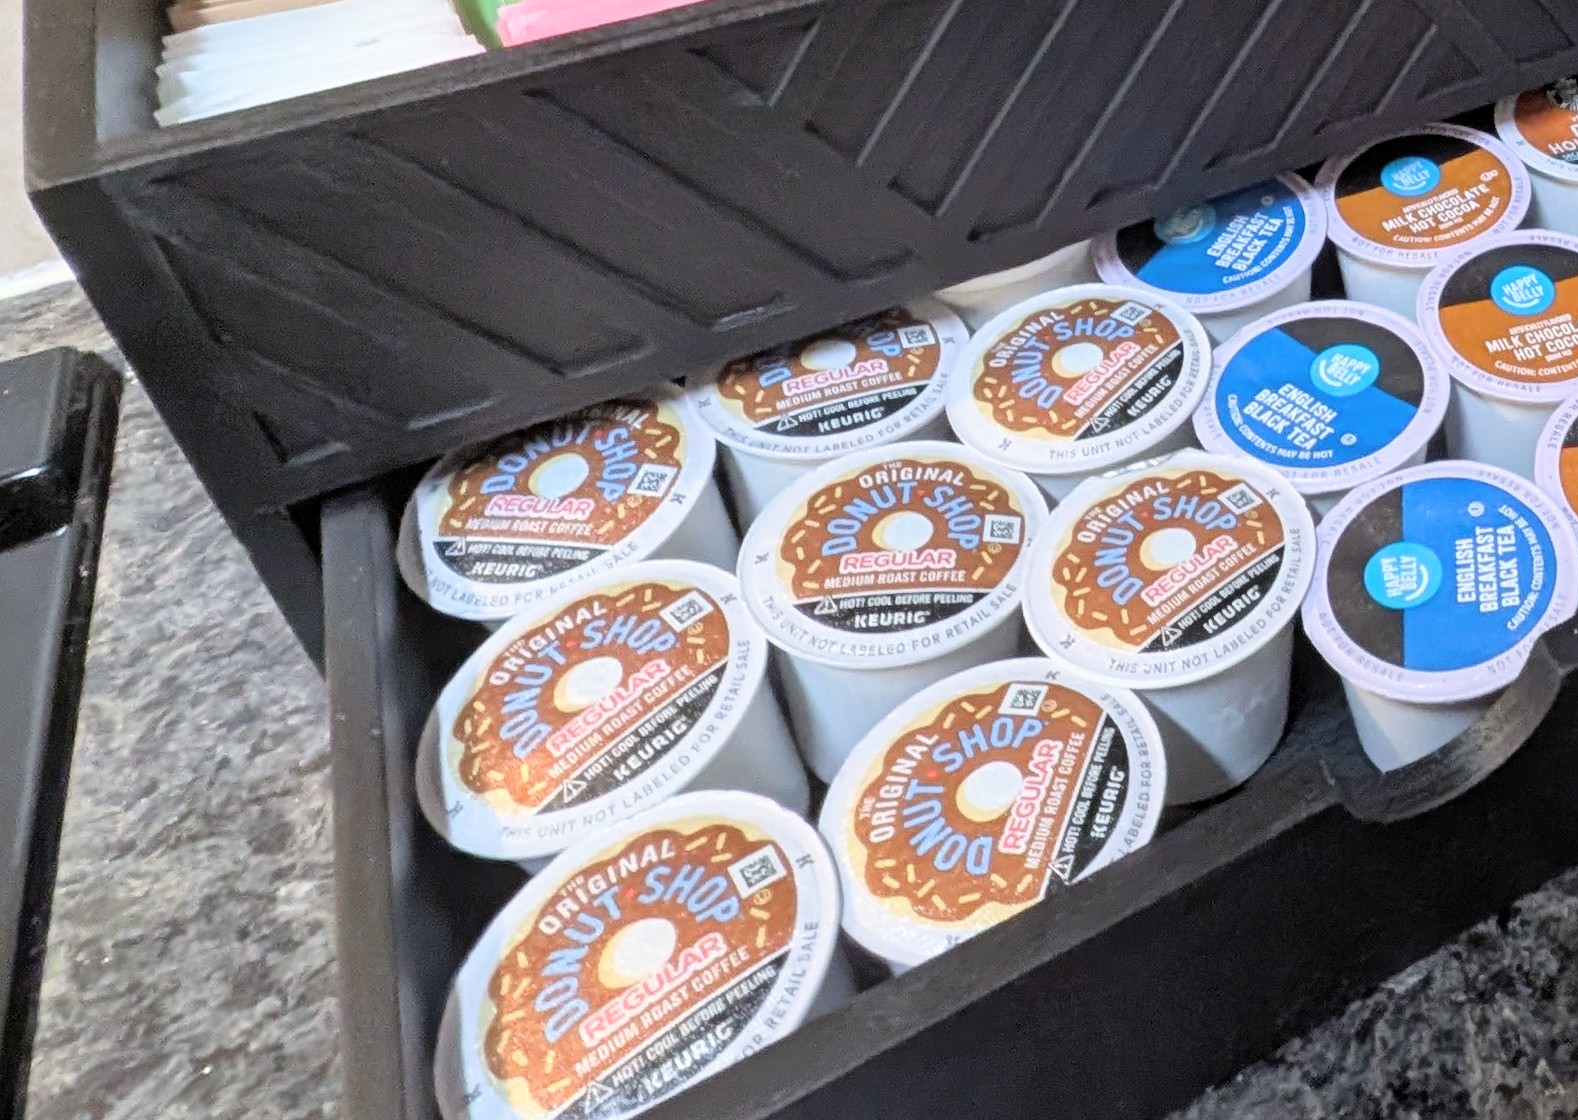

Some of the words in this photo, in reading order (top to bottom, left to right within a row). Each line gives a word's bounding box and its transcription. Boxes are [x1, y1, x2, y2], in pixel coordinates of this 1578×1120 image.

[1392, 162, 1423, 180] HAPPY
[1400, 170, 1430, 187] BELLY
[1382, 215, 1419, 232] MILK
[1418, 184, 1490, 218] CHOCOLATE
[1409, 217, 1435, 234] HOT
[1438, 201, 1480, 223] COCOA
[1207, 215, 1249, 257] ENGLISH
[1216, 212, 1269, 268] BREAKFAST
[1232, 237, 1268, 271] BLACK
[1259, 218, 1284, 237] TEA
[1502, 274, 1538, 295] HAPPY
[1511, 285, 1544, 303] BELLY
[989, 312, 1065, 368] ORIGINAL
[1012, 335, 1063, 408] DONUT
[1052, 318, 1134, 341] SHOP
[1331, 352, 1373, 373] HAPPY
[1485, 337, 1523, 353] MILK
[1514, 343, 1542, 362] HOT
[776, 390, 822, 411] MEDIUM
[825, 383, 858, 398] ROAST
[862, 372, 902, 387] COFFEE
[783, 359, 888, 395] REGULAR
[1064, 341, 1141, 405] REGULAR
[1075, 391, 1106, 419] MEDIUM
[1105, 369, 1129, 394] ROAST
[1129, 346, 1158, 369] COFFEE
[1326, 363, 1362, 385] BELLY
[1494, 361, 1536, 377] CAUTION:
[818, 408, 884, 432] KEURIG
[1128, 375, 1172, 417] KEURIG
[1254, 388, 1334, 440] BREAKFAST
[1277, 383, 1338, 422] ENGLISH
[1239, 424, 1277, 454] CONTENTS
[1276, 447, 1298, 458] MAY
[1298, 450, 1311, 459] BE
[1313, 450, 1333, 459] HOT
[1243, 401, 1290, 435] BLACK
[1286, 427, 1318, 450] TEA
[595, 427, 639, 503] SHOP
[859, 468, 965, 488] ORIGINAL
[883, 463, 901, 471] THE
[485, 495, 595, 519] REGULAR
[822, 482, 917, 557] DONUT
[923, 486, 982, 550] SHOP
[1078, 481, 1170, 543] ORIGINAL
[1085, 507, 1103, 520] THE
[840, 549, 957, 573] REGULAR
[1095, 510, 1144, 604] DONUT
[1153, 496, 1236, 531] SHOP
[1497, 525, 1516, 554] TEA
[1523, 528, 1538, 545] MAY
[468, 562, 544, 578] KEURIG
[824, 573, 874, 588] MEDIUM
[877, 572, 916, 584] ROAST
[919, 570, 966, 582] COFFEE
[1141, 534, 1238, 607] REGULAR
[1148, 591, 1189, 626] MEDIUM
[1189, 568, 1220, 594] ROAST
[1220, 544, 1256, 571] COFFEE
[1381, 557, 1397, 597] HAPPY
[1400, 555, 1417, 590] BELLY
[1455, 538, 1476, 603] ENGLISH
[1475, 526, 1499, 613] BREAKFAST
[1501, 557, 1520, 608] BLACK
[1530, 545, 1544, 590] CONTENTS
[854, 611, 930, 628] KEURIG
[867, 596, 892, 607] COOL
[895, 594, 931, 605] BEFORE
[934, 593, 973, 604] PEELING
[912, 634, 941, 650] FOR
[945, 608, 990, 638] RETAIL
[990, 583, 1017, 609] SALE
[1202, 585, 1261, 634] KEURIG
[1507, 591, 1538, 631] CAUTION:
[489, 602, 608, 686] ORIGINAL
[1182, 653, 1210, 669] NOT
[1216, 619, 1266, 658] LABELED
[500, 643, 568, 758] DONUT
[580, 616, 677, 653] SHOP
[546, 658, 671, 758] REGULAR
[549, 734, 602, 778] MEDIUM
[604, 703, 643, 738] ROAST
[644, 664, 695, 705] COFFEE
[933, 717, 1043, 773] SHOP
[614, 717, 690, 781] KEURIG
[859, 797, 874, 819] THE
[870, 732, 939, 843] ORIGINAL
[998, 739, 1064, 854] REGULAR
[1025, 810, 1054, 870] MEDIUM
[1050, 775, 1068, 815] ROAST
[1059, 732, 1085, 776] COFFEE
[1090, 766, 1125, 839] KEURIG
[903, 780, 993, 875] DONUT
[538, 839, 677, 936] ORIGINAL
[560, 876, 585, 896] THE
[536, 887, 623, 1044] DONUT
[638, 865, 743, 923] SHOP
[766, 973, 805, 1030] RETAIL
[800, 920, 820, 971] SALE
[575, 1022, 638, 1077] MEDIUM
[641, 985, 689, 1026] ROAST
[692, 946, 749, 992] COFFEE
[580, 932, 727, 1048] REGULAR
[642, 1020, 734, 1092] KEURIG
